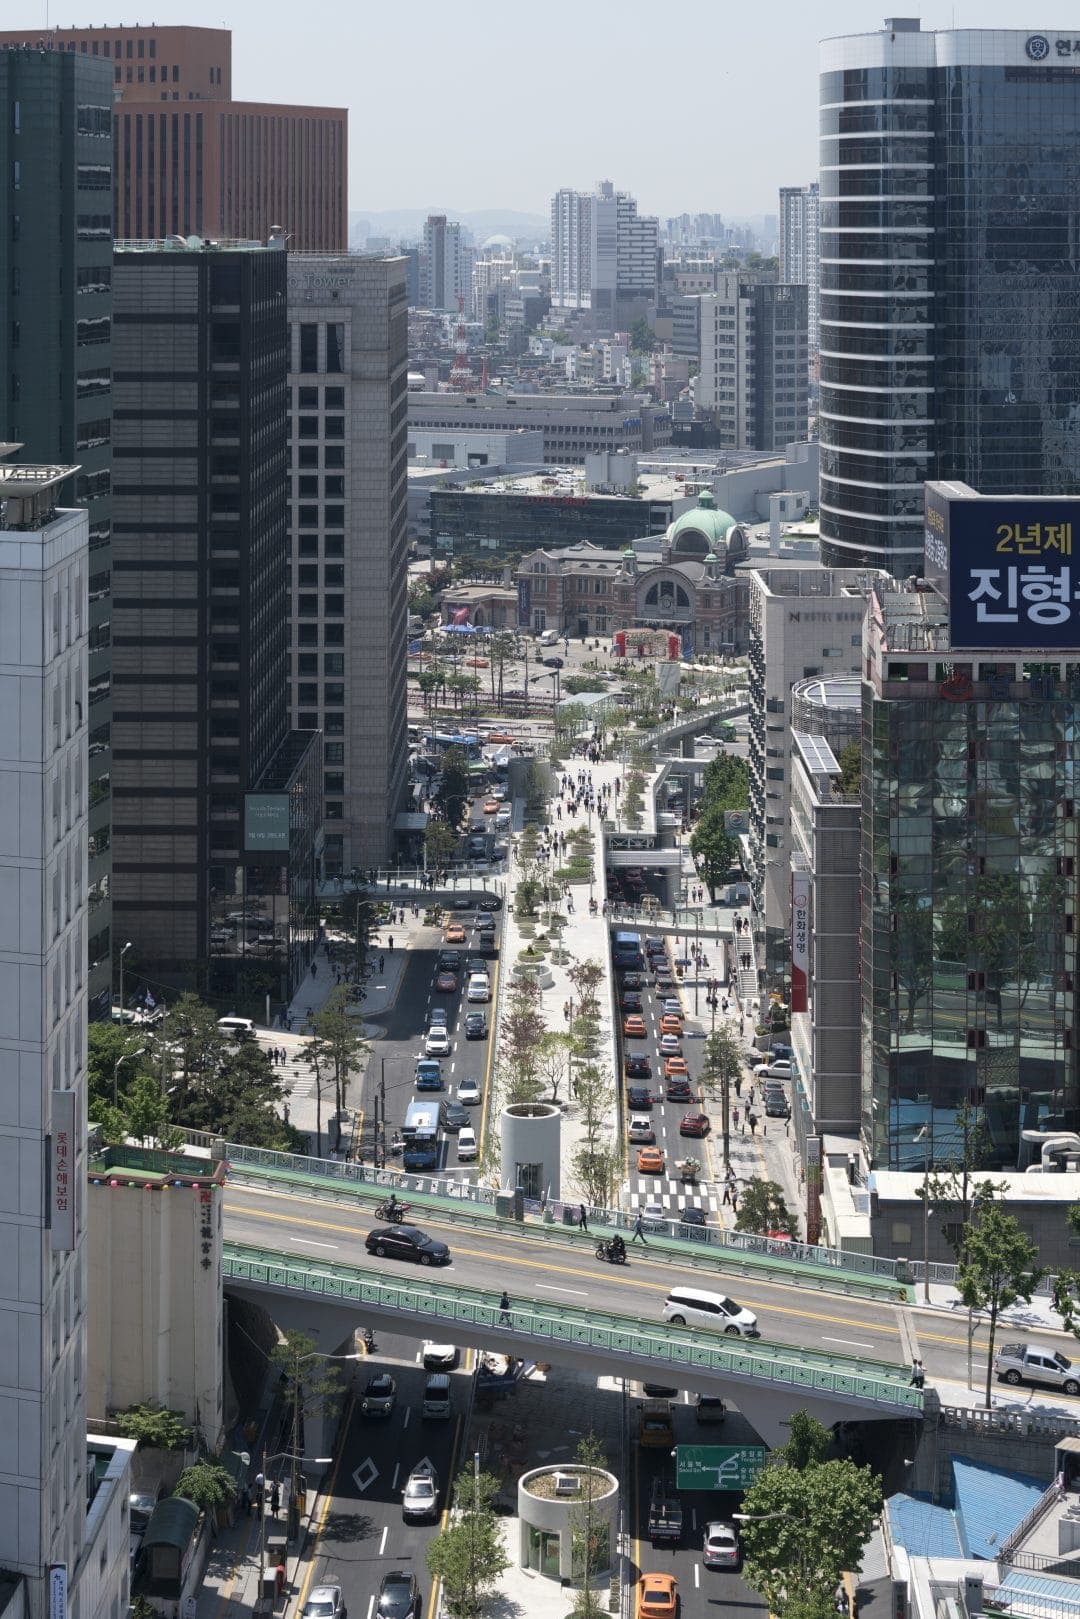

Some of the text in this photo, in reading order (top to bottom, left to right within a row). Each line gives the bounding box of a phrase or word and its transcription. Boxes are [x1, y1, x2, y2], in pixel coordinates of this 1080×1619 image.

[304, 274, 351, 288] Tower
[996, 522, 1072, 556] 2년제
[967, 565, 1080, 625] 진형
[796, 909, 806, 954] 한화생명
